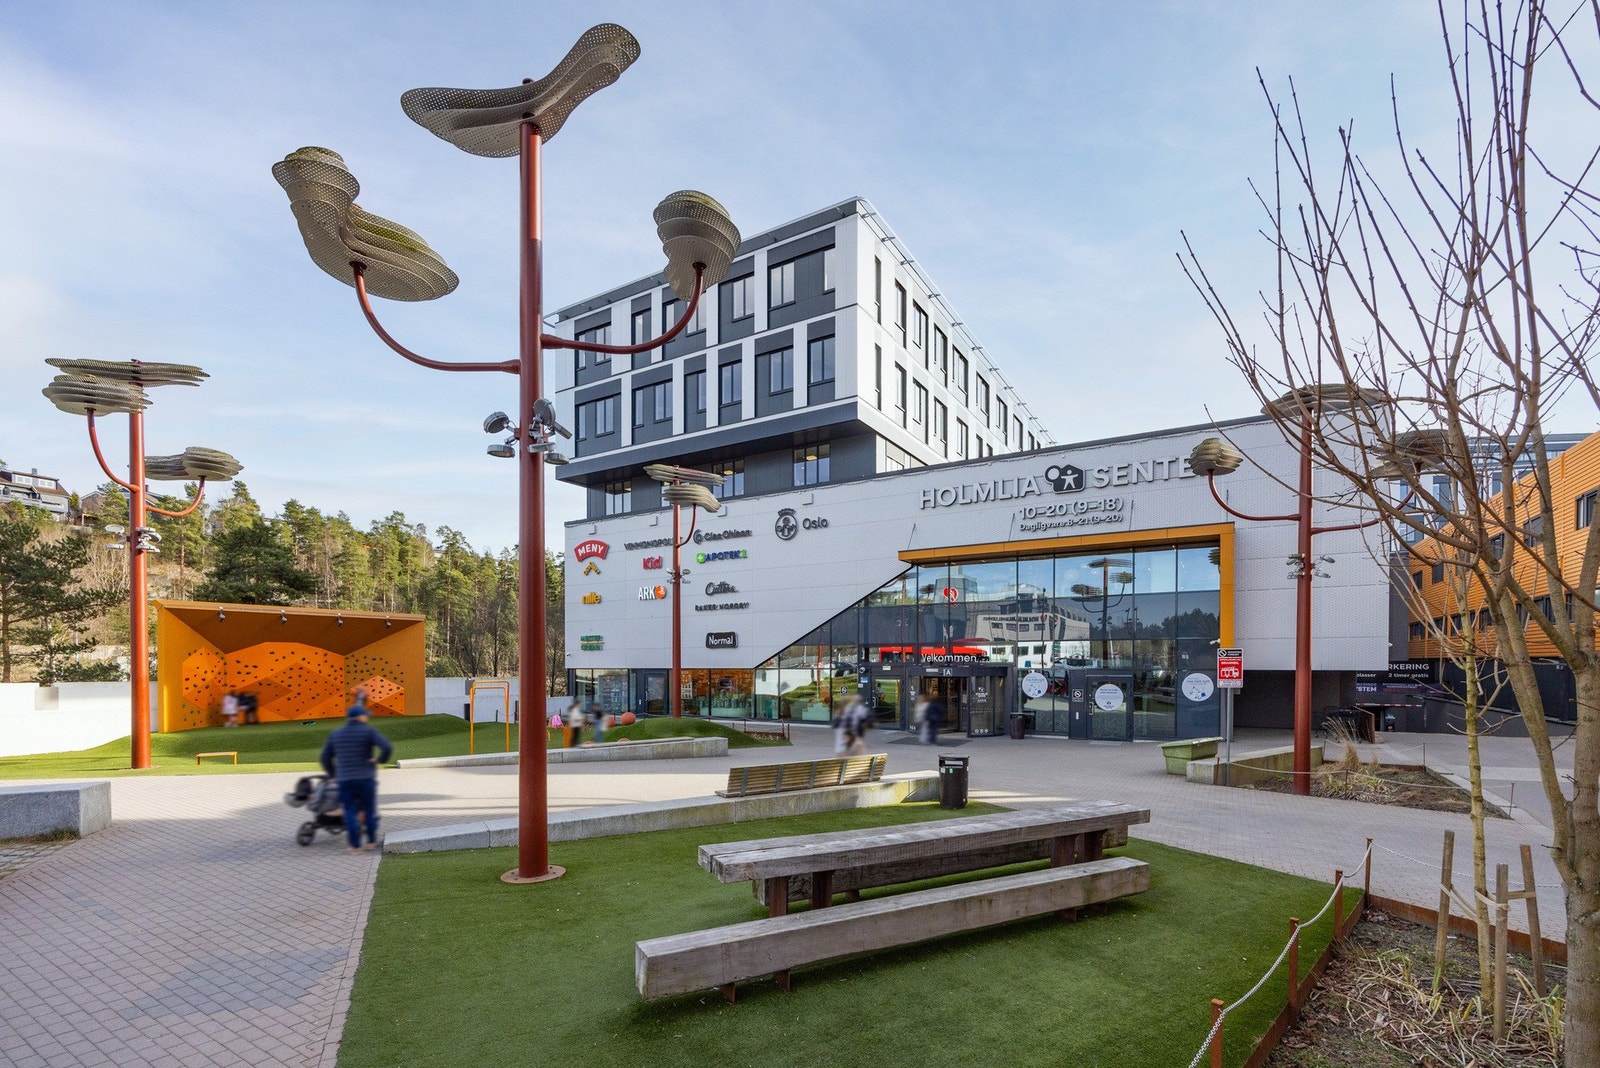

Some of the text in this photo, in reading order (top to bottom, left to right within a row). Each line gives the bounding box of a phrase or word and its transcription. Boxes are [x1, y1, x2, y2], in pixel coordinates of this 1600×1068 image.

[920, 456, 1197, 510] HOLMLIA SENTE
[802, 516, 828, 530] Oslo
[578, 543, 604, 556] MENY
[624, 537, 683, 550] VINMONOPOL
[643, 556, 662, 569] Kid
[638, 586, 655, 600] ARK
[708, 635, 733, 645] Normal
